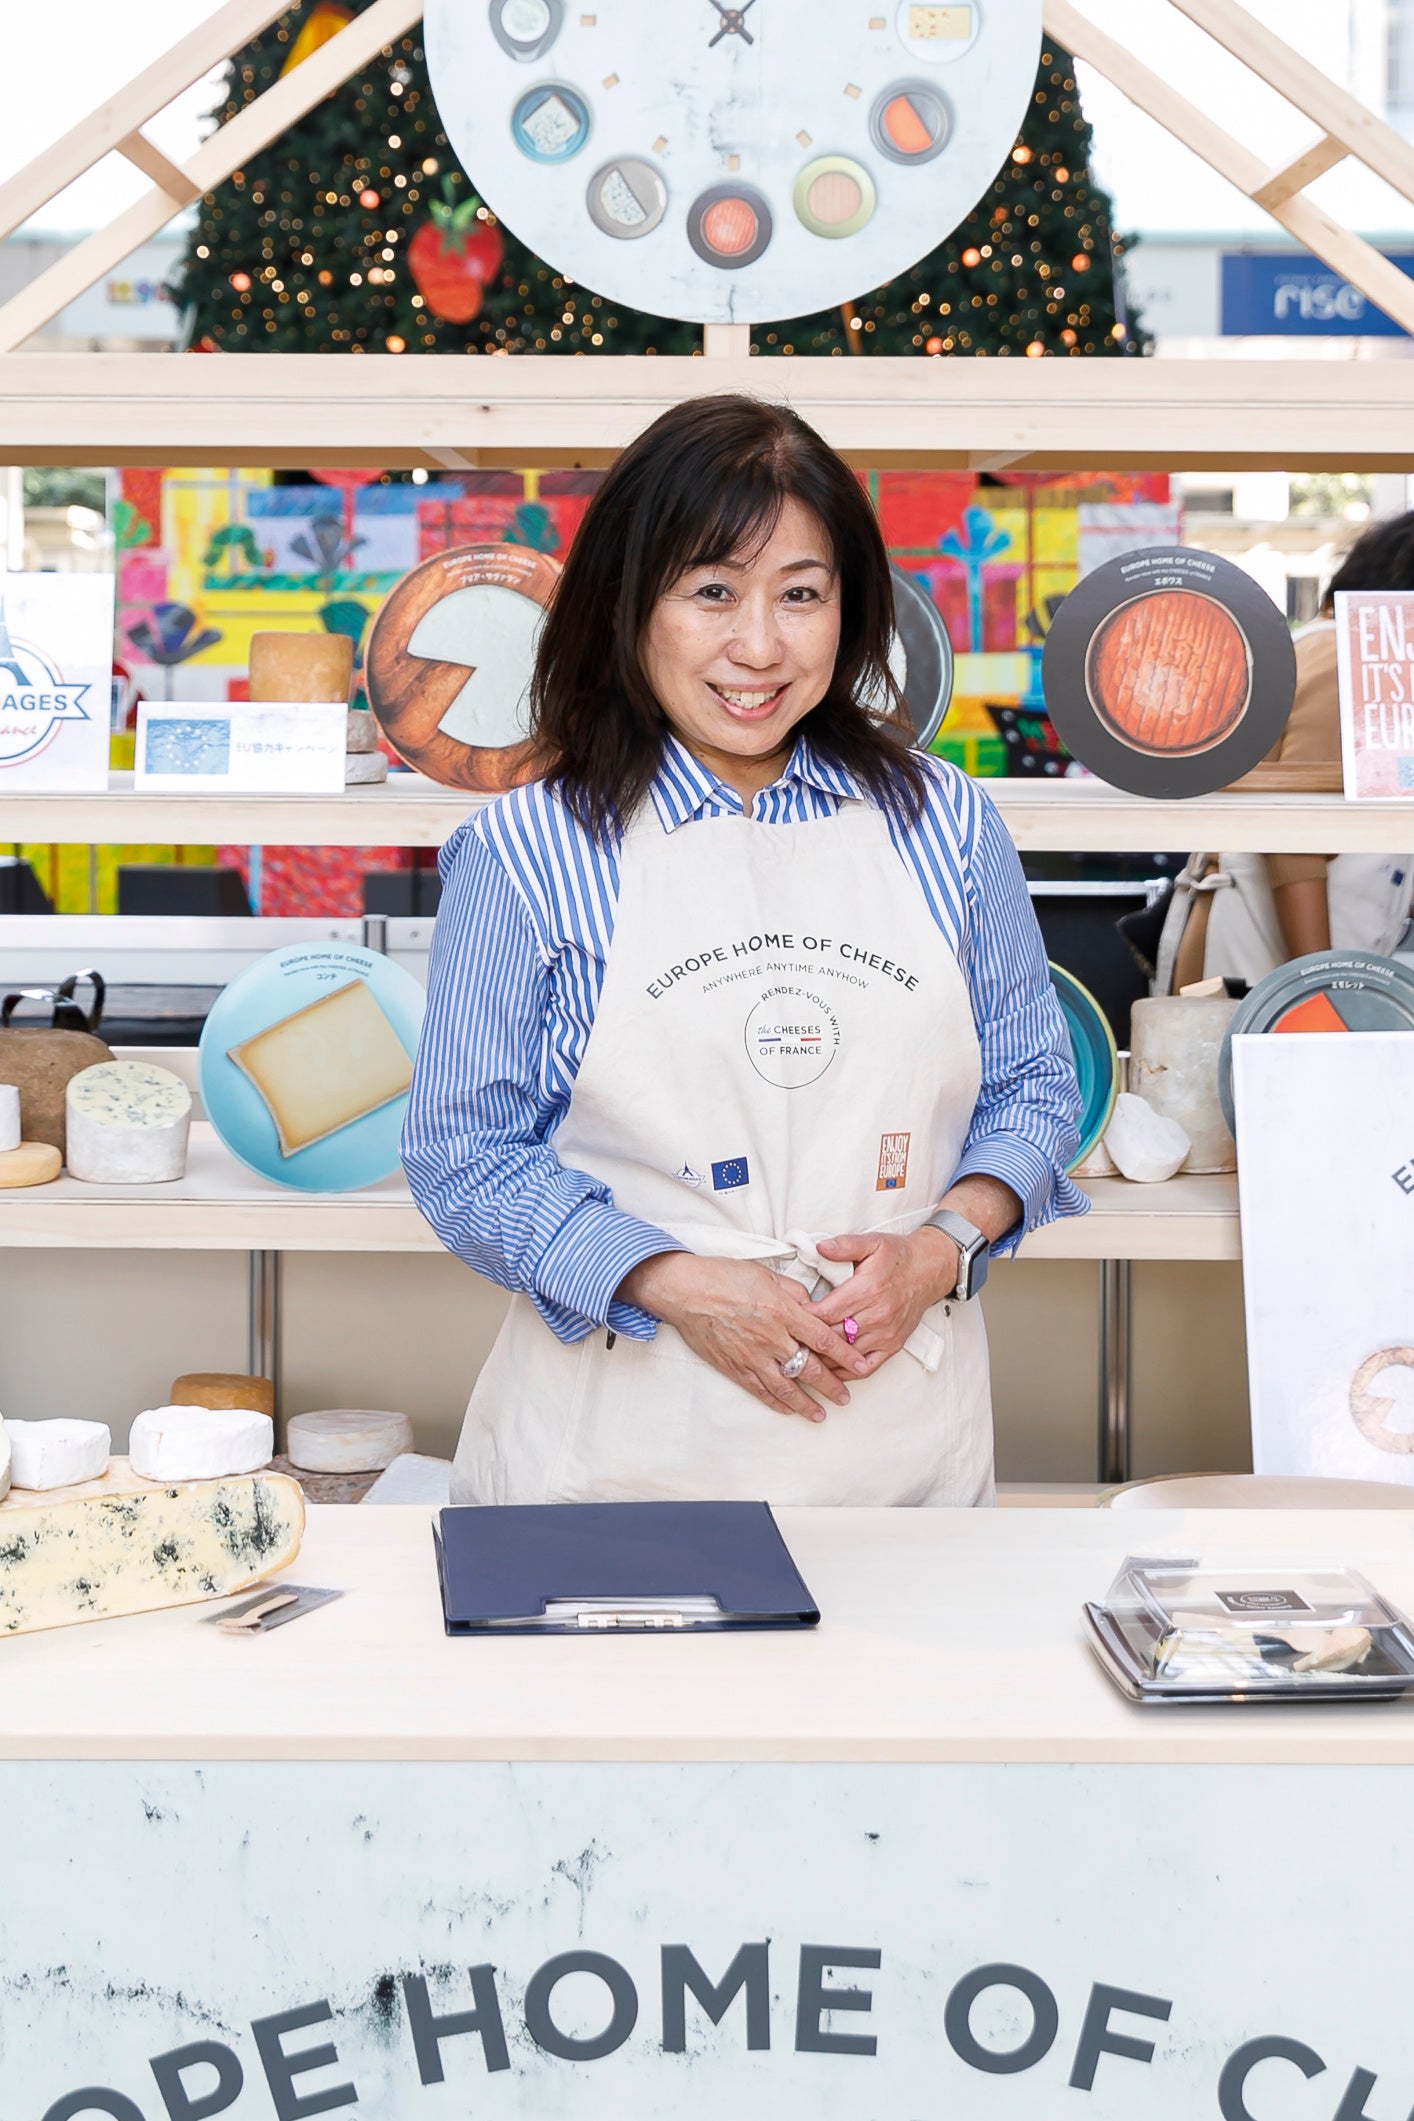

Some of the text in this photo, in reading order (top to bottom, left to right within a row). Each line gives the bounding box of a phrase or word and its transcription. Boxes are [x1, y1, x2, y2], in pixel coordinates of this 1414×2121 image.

[1274, 284, 1365, 320] rise
[1120, 559, 1150, 574] EUROPE
[1151, 557, 1174, 565] HOME
[1175, 557, 1186, 565] OF
[1358, 604, 1414, 662] EN
[1361, 663, 1405, 703] IT'S
[2, 694, 67, 711] AGES
[280, 954, 308, 968] EUROPE
[345, 955, 373, 968] CHEESE
[646, 934, 920, 1000] EUROPE HOME OF CHEESE
[1300, 962, 1330, 976] EUROPE
[1331, 961, 1353, 969] HOME
[1354, 961, 1365, 969] OF
[702, 963, 869, 994] ANYWHERE ANYTIME ANYHOW
[760, 986, 841, 1046] RENDEZ-VOUS WITH
[757, 1025, 822, 1035] the CHEESES
[759, 1045, 822, 1056] OF FRANCE
[882, 1135, 909, 1153] ENJOY
[879, 1163, 905, 1178] EUROPE
[1391, 1159, 1414, 1195] E
[402, 1943, 882, 2086] HOME
[943, 1961, 1173, 2092] OF
